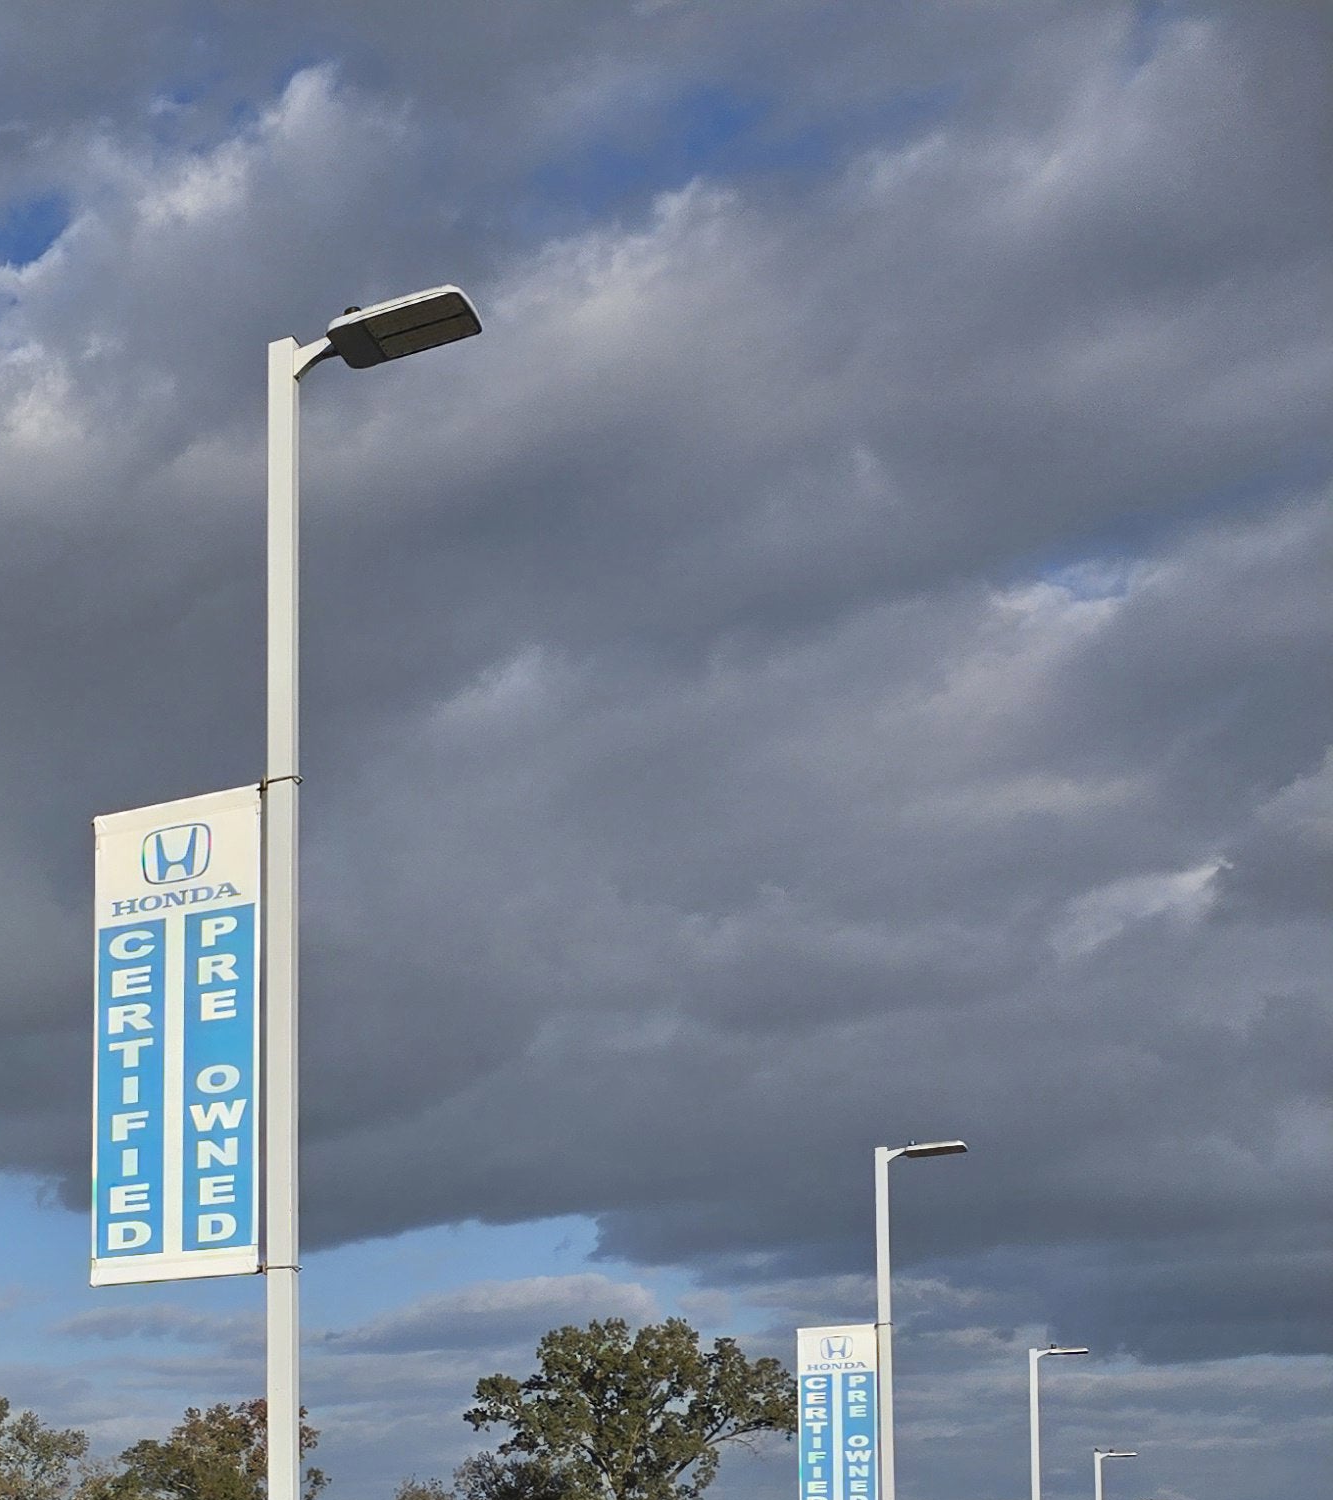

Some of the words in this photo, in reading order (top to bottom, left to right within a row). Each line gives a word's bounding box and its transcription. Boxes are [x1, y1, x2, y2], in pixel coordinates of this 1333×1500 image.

[112, 882, 241, 917] HONDA
[197, 916, 239, 1022] PRE
[108, 930, 155, 1250] CERTIFIED
[189, 1064, 247, 1243] OWNED
[806, 1361, 867, 1371] HONDA
[847, 1375, 867, 1418] PRE
